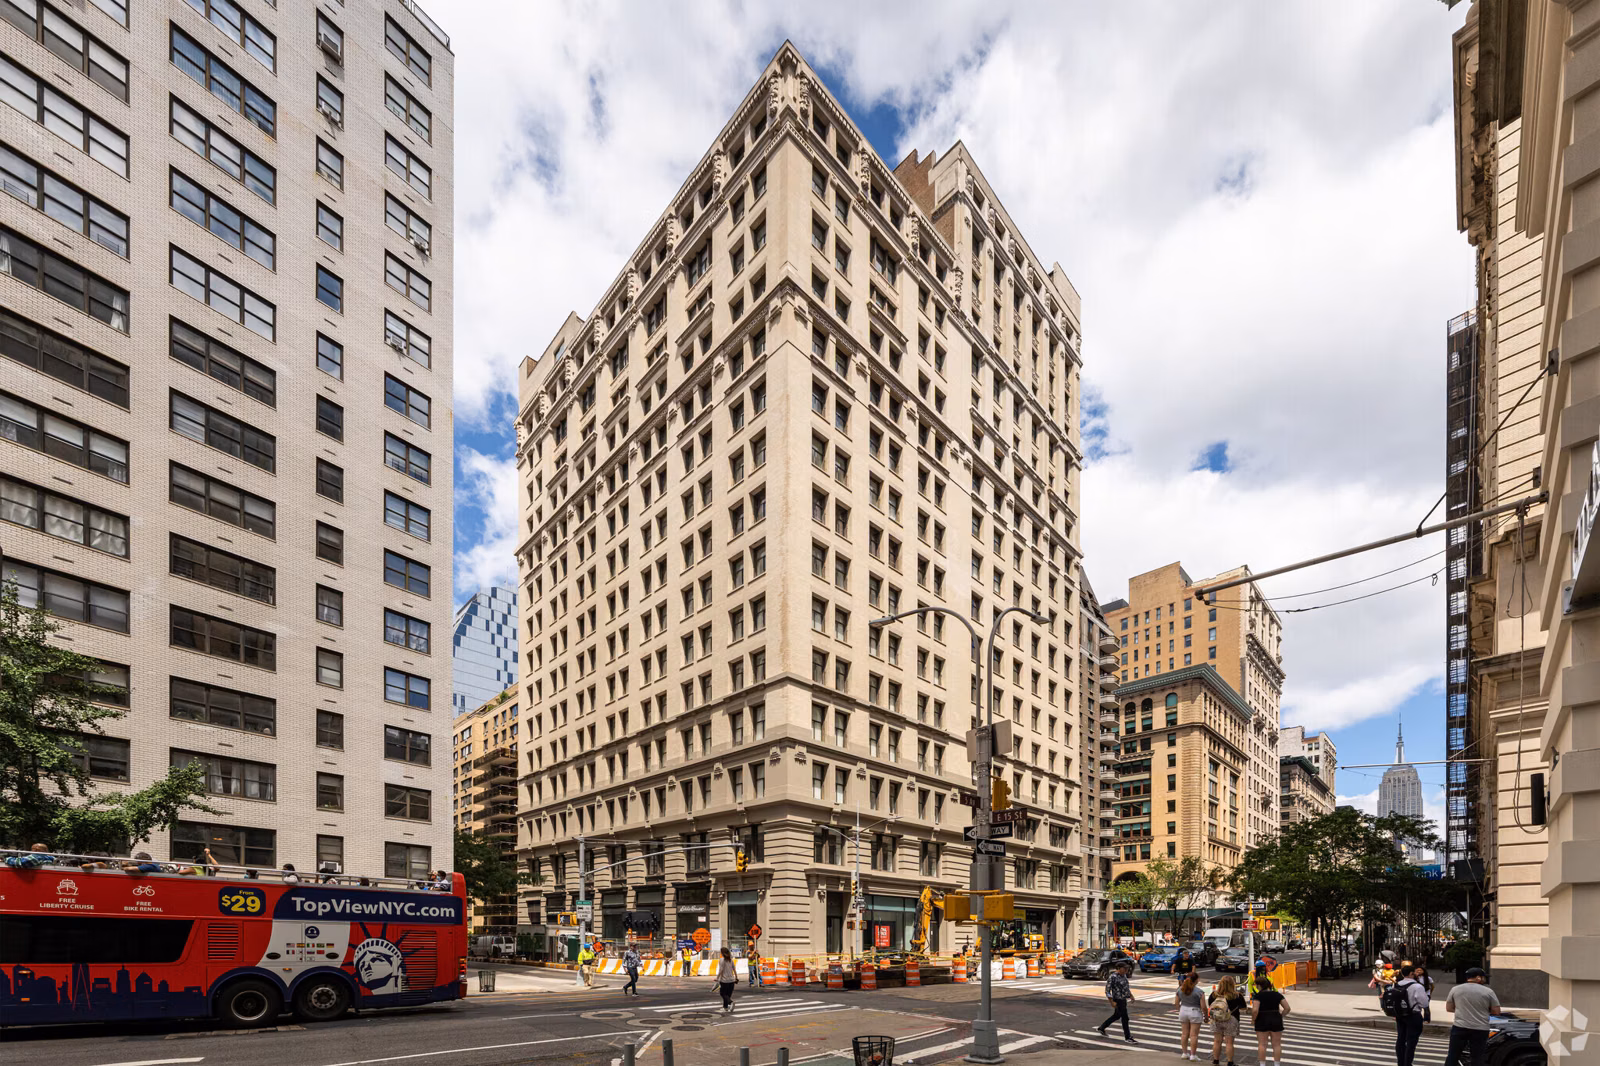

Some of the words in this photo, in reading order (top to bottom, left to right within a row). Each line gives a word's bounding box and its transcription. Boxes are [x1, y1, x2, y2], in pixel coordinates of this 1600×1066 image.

[997, 813, 1001, 822] E
[1004, 811, 1012, 821] 15
[1015, 810, 1022, 820] St
[221, 895, 260, 913] $29
[291, 896, 455, 917] TopViewNYC.com
